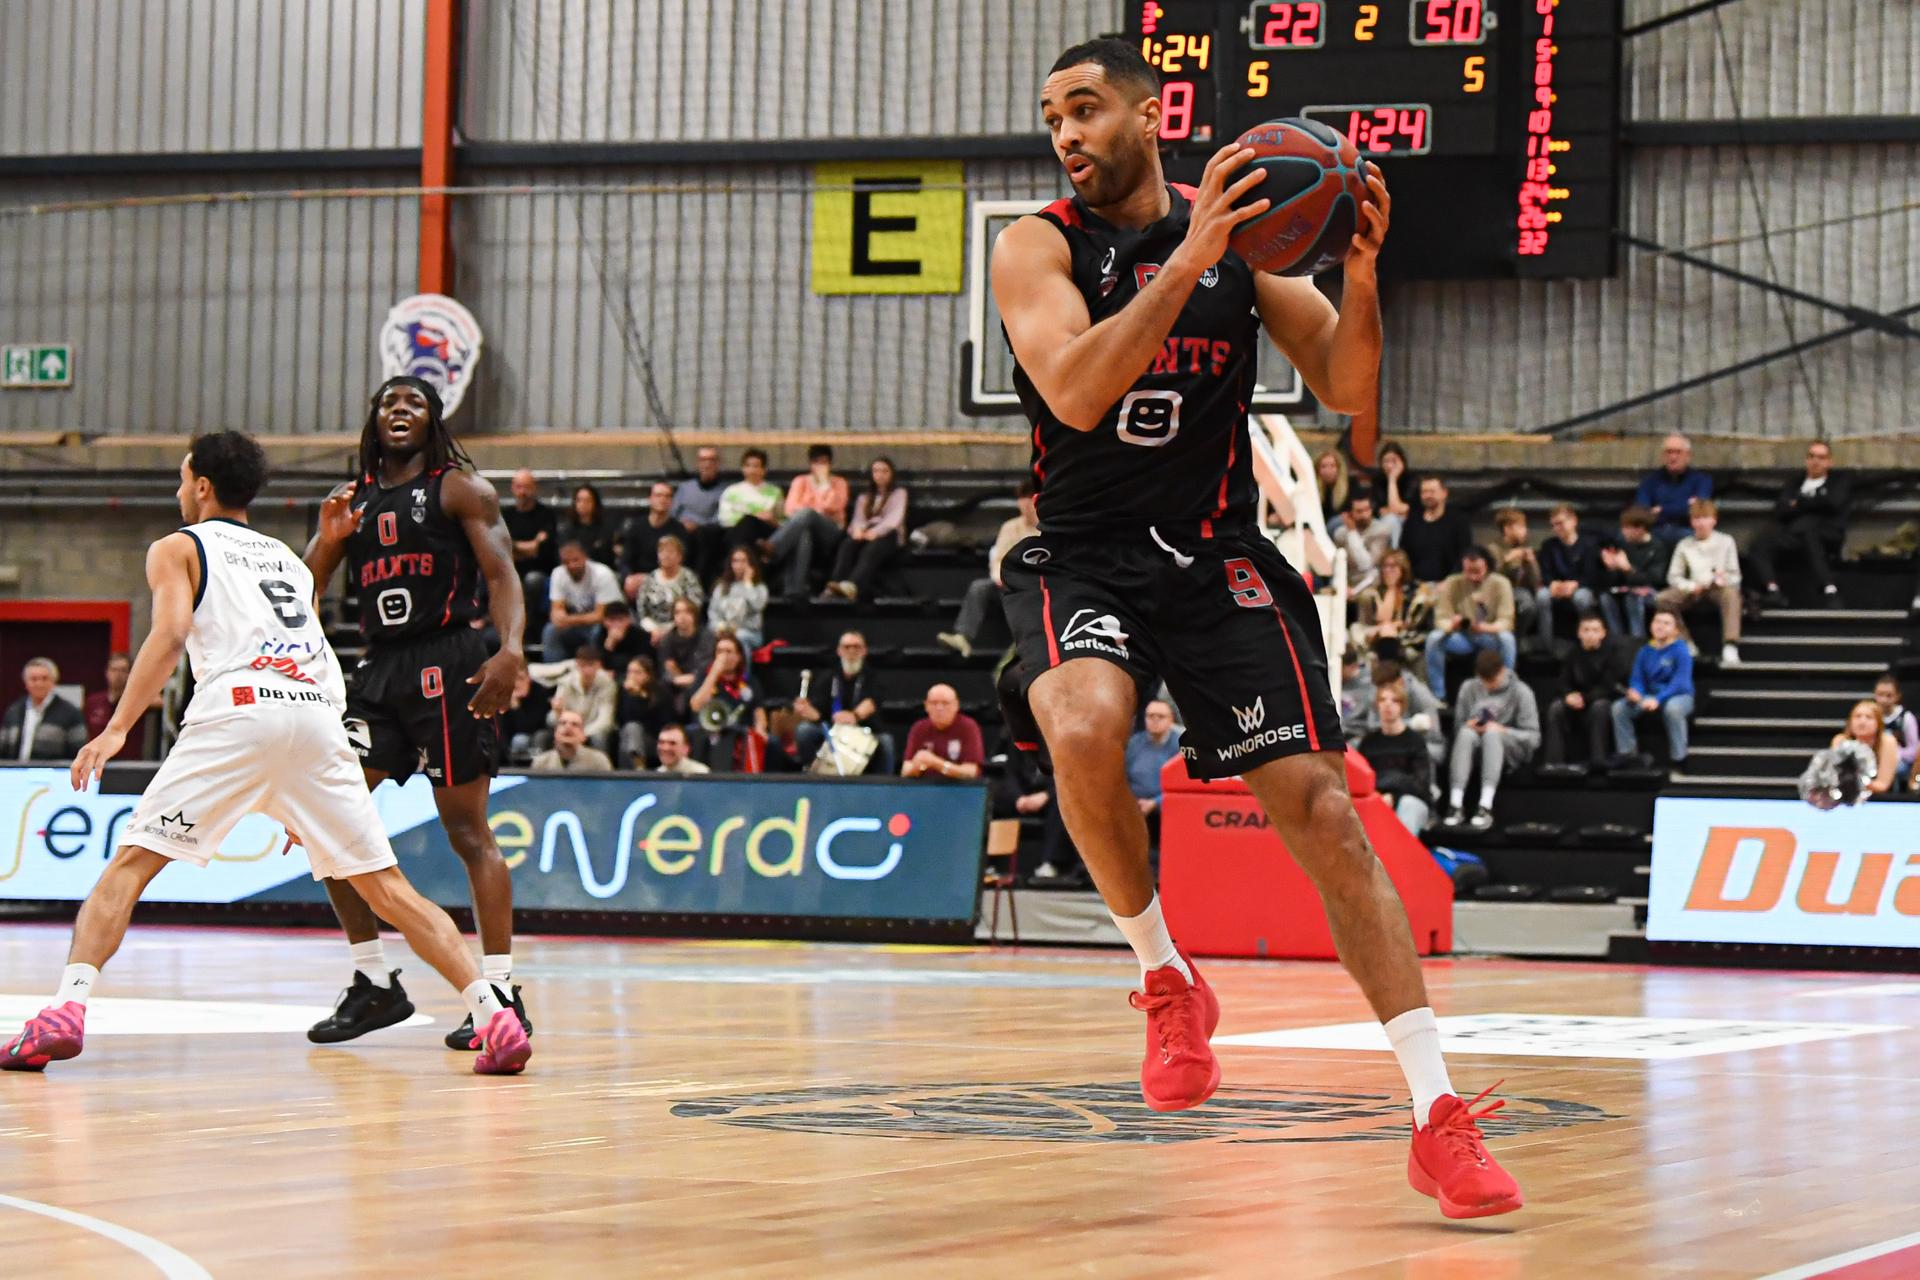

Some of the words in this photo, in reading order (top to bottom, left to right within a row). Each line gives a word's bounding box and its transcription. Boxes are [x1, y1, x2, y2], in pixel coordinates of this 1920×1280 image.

[1264, 3, 1319, 47] 22
[1354, 5, 1379, 41] 2
[1425, 0, 1481, 42] 50
[1543, 14, 1554, 36] 1
[1142, 35, 1210, 73] 1:24
[1536, 38, 1552, 62] 5
[1247, 61, 1270, 97] 5
[1463, 56, 1486, 92] 5
[1535, 62, 1552, 85] 8
[1536, 86, 1552, 109] 9
[1348, 108, 1425, 152] 1:24
[1528, 110, 1552, 133] 10
[1527, 135, 1551, 157] 11
[1527, 157, 1549, 181] 13
[852, 176, 922, 276] E
[1518, 230, 1548, 254] 32
[1147, 337, 1231, 377] NTS
[377, 511, 398, 546] 0
[1224, 557, 1274, 608] 9
[259, 579, 308, 629] 6
[259, 687, 284, 699] DB
[287, 691, 331, 707] VIDE
[421, 666, 443, 699] 0
[1217, 724, 1306, 762] WINDROSE
